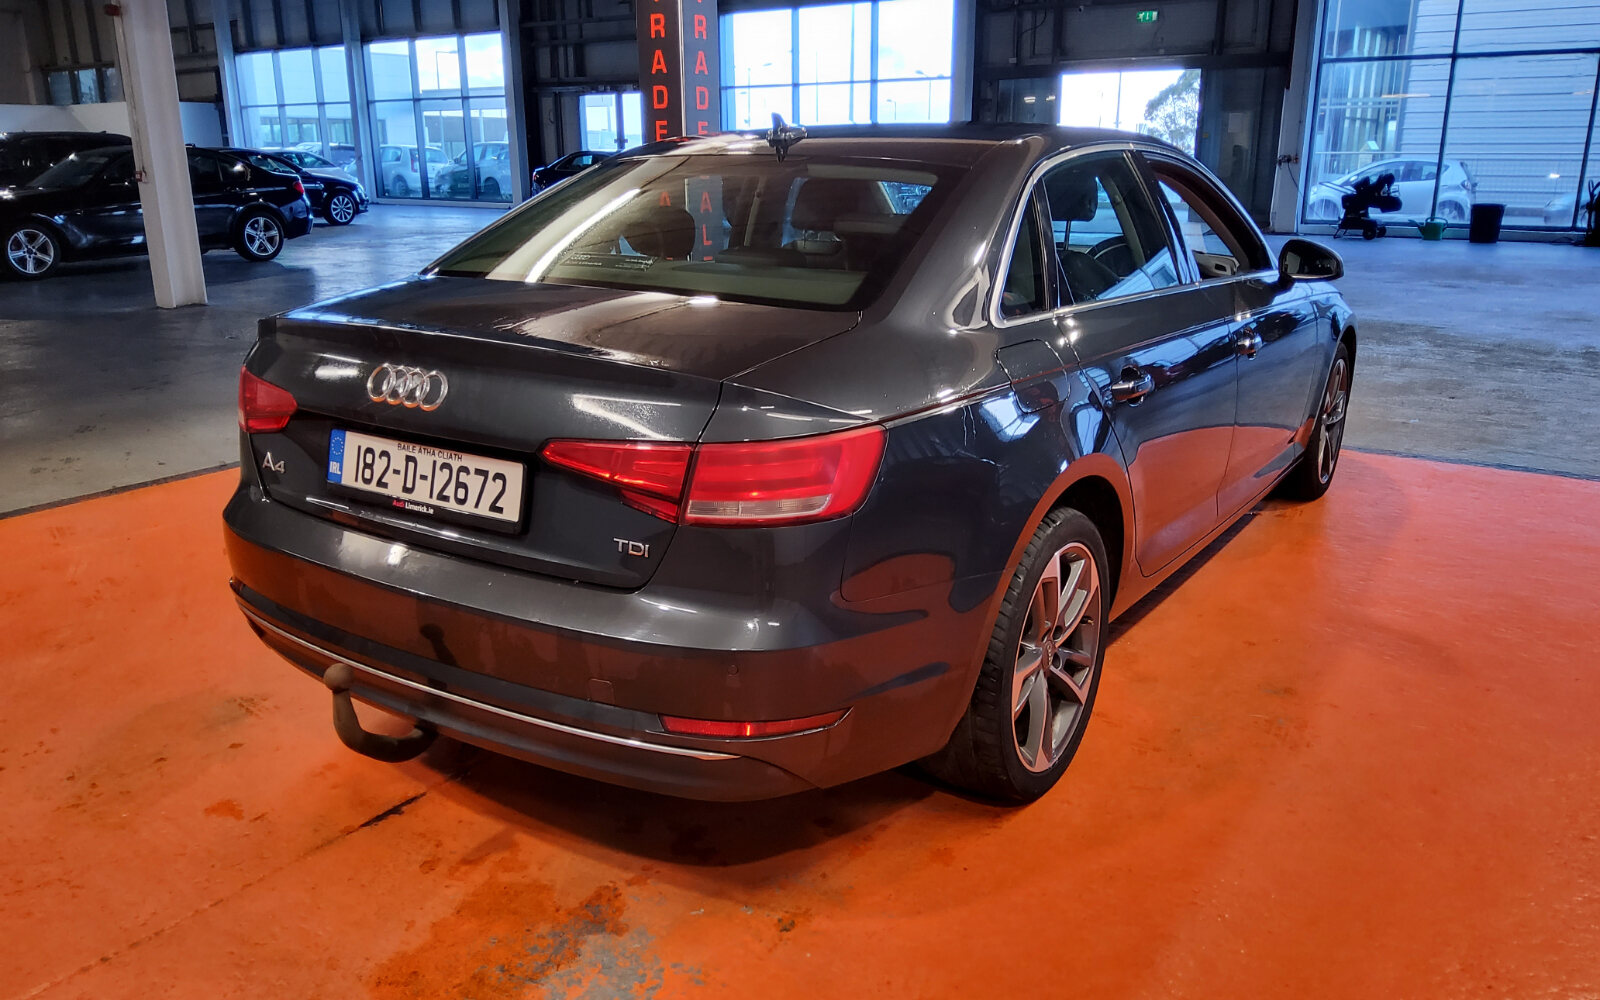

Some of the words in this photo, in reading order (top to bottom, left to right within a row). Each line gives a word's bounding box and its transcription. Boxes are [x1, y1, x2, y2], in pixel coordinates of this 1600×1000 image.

[650, 0, 668, 141] RADE
[694, 0, 709, 135] RADE
[262, 451, 285, 473] A4
[397, 442, 416, 453] BAILE
[437, 450, 463, 461] CLIATH
[330, 461, 342, 474] IRL
[354, 445, 507, 514] 182-D-12672
[613, 537, 650, 558] TDI
